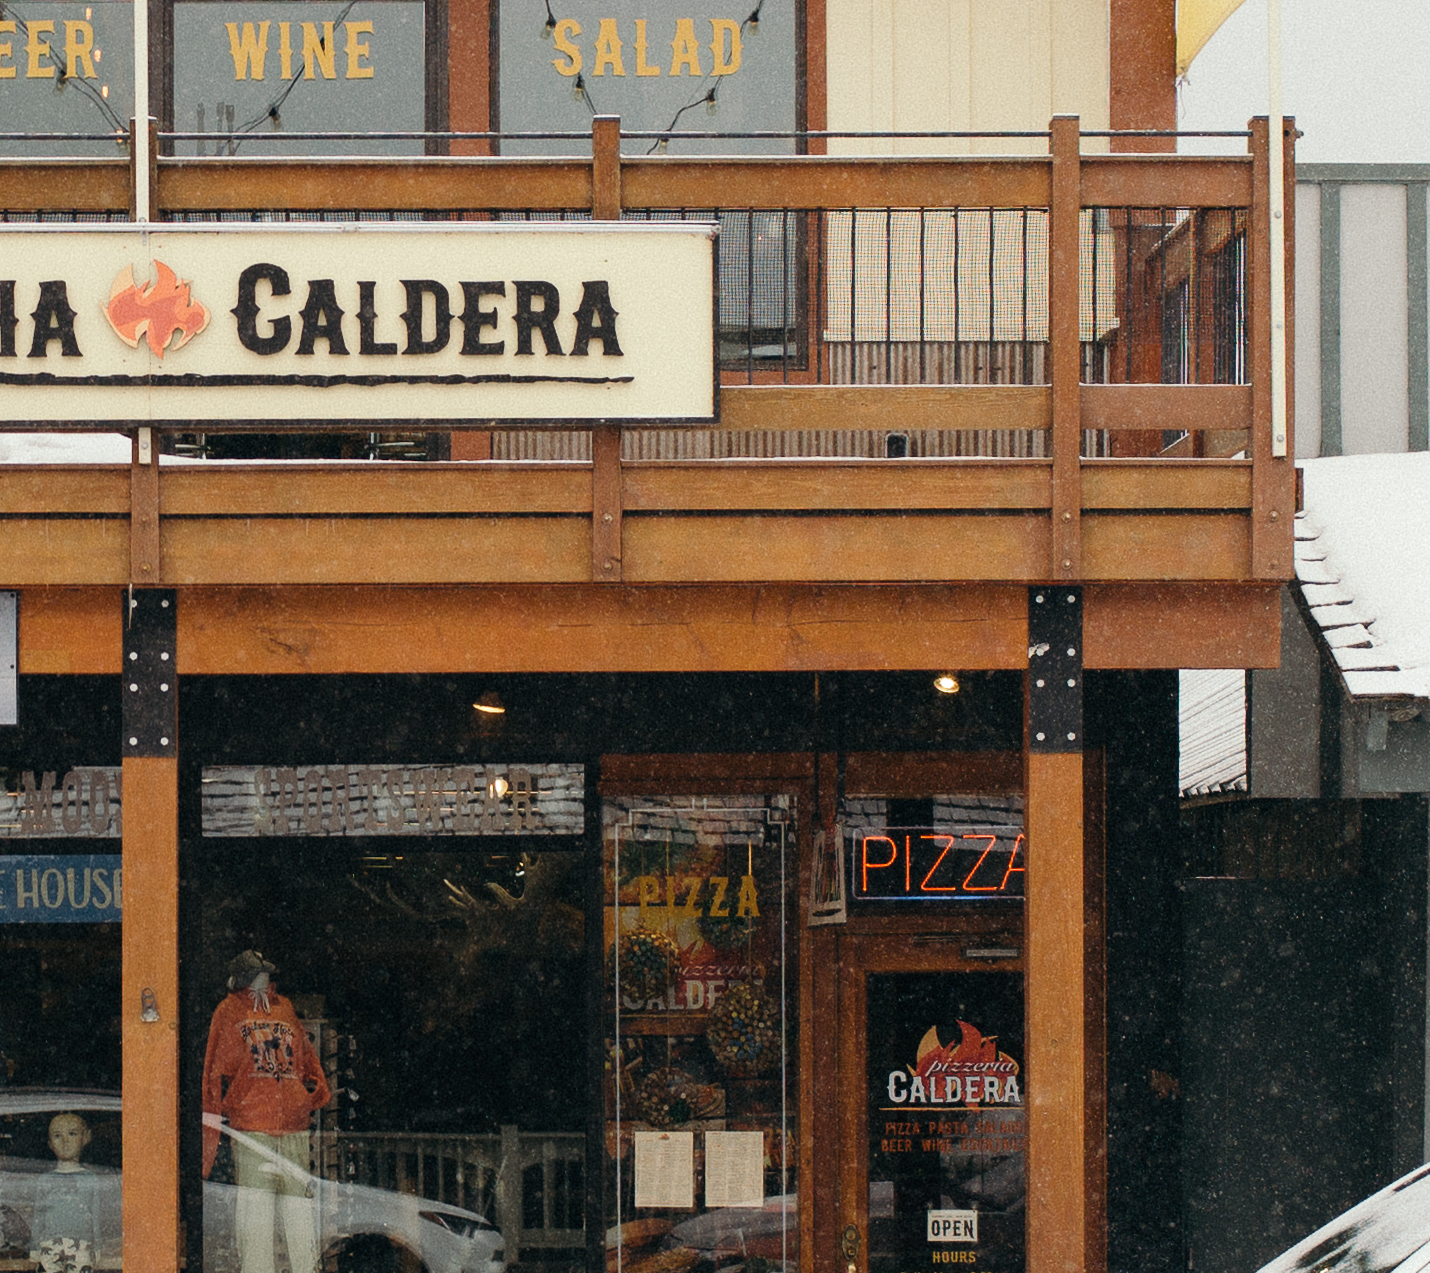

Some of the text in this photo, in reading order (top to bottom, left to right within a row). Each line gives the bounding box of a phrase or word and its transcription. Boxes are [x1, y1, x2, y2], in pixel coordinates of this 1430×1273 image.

[225, 19, 375, 81] WINE
[551, 17, 744, 78] SALAD
[229, 261, 624, 358] CALDERA
[638, 875, 761, 918] PIZZA
[926, 1057, 1018, 1077] pizzeria
[886, 1070, 1021, 1103] CALDERA
[884, 1121, 920, 1135] PIZZA
[880, 1137, 913, 1153] BEER
[931, 1219, 974, 1239] OPEN
[932, 1251, 977, 1264] HOURS
